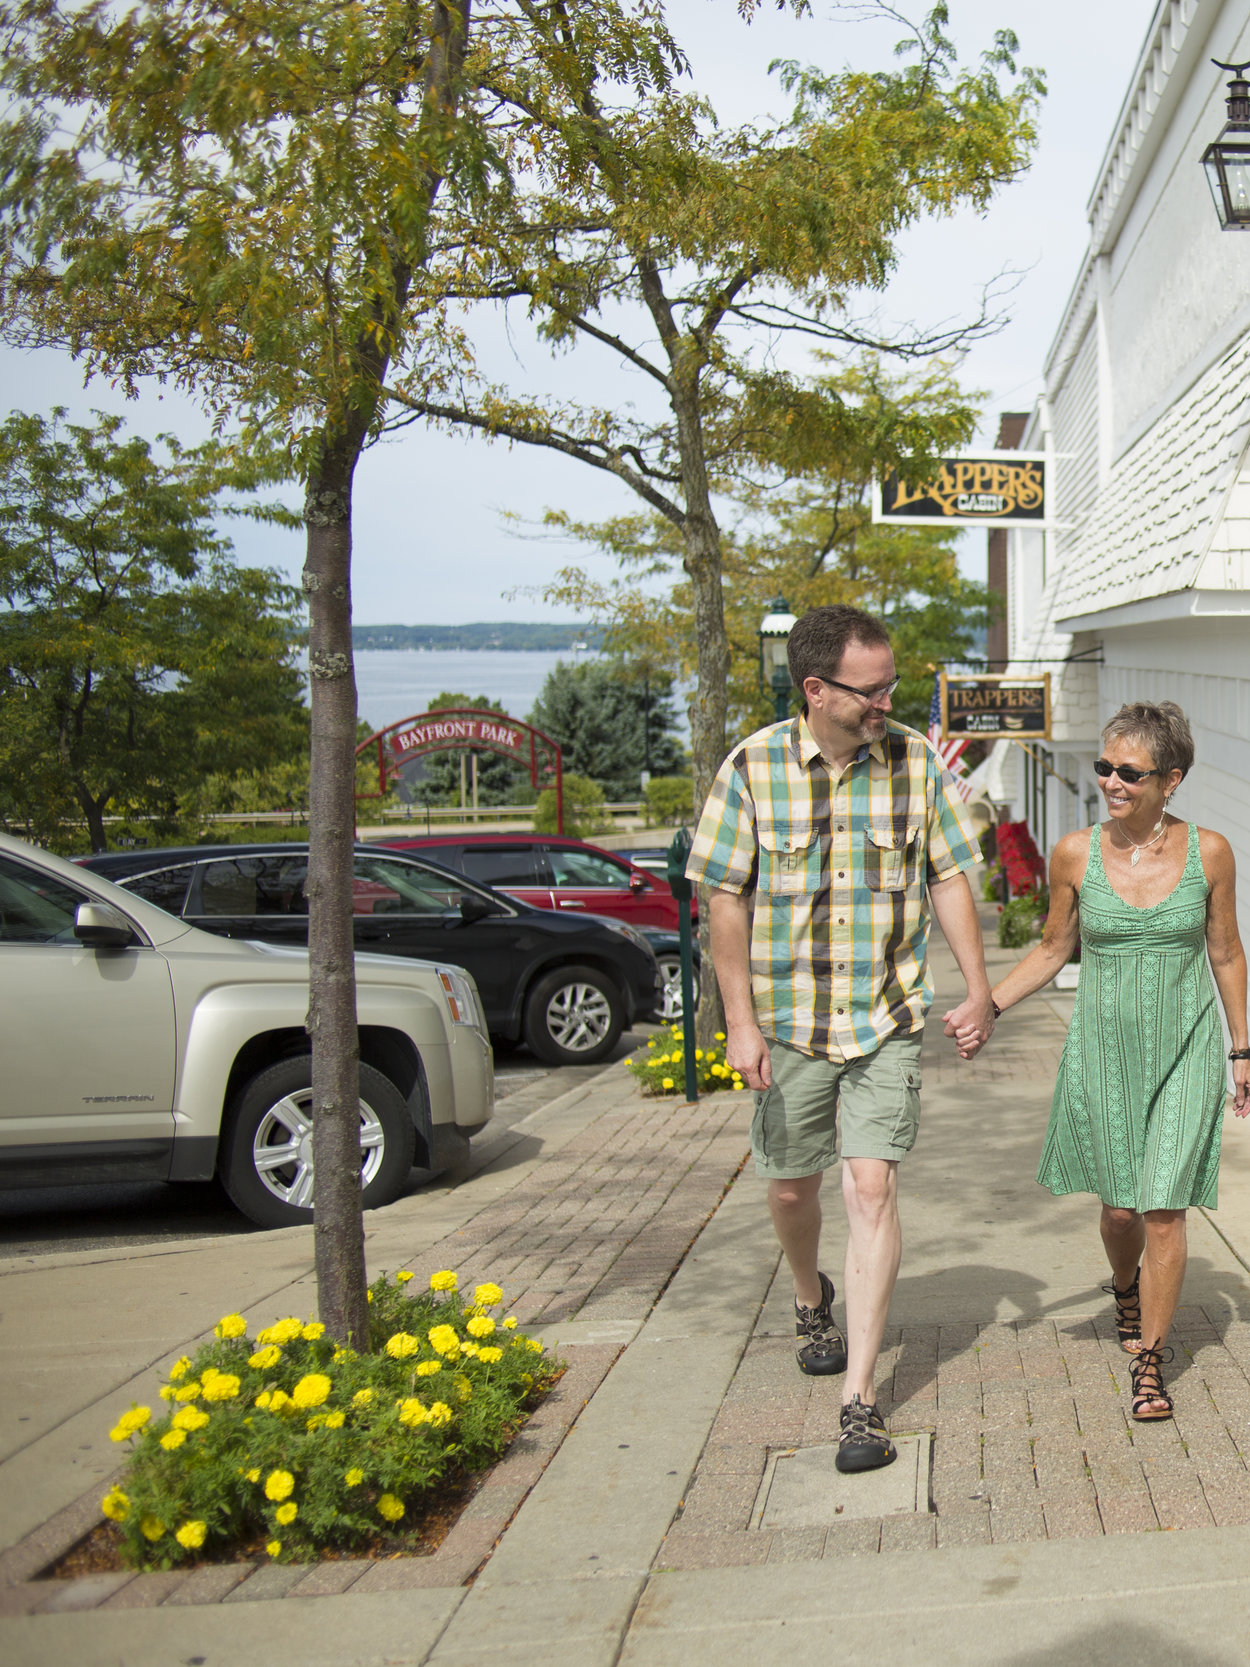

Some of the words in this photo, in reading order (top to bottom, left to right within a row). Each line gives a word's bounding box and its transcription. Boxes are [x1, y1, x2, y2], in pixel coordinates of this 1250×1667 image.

[957, 494, 1004, 511] CABIN
[398, 721, 476, 750] BAYFRONT
[481, 723, 517, 747] PARK
[82, 1095, 155, 1103] TERRAIN
